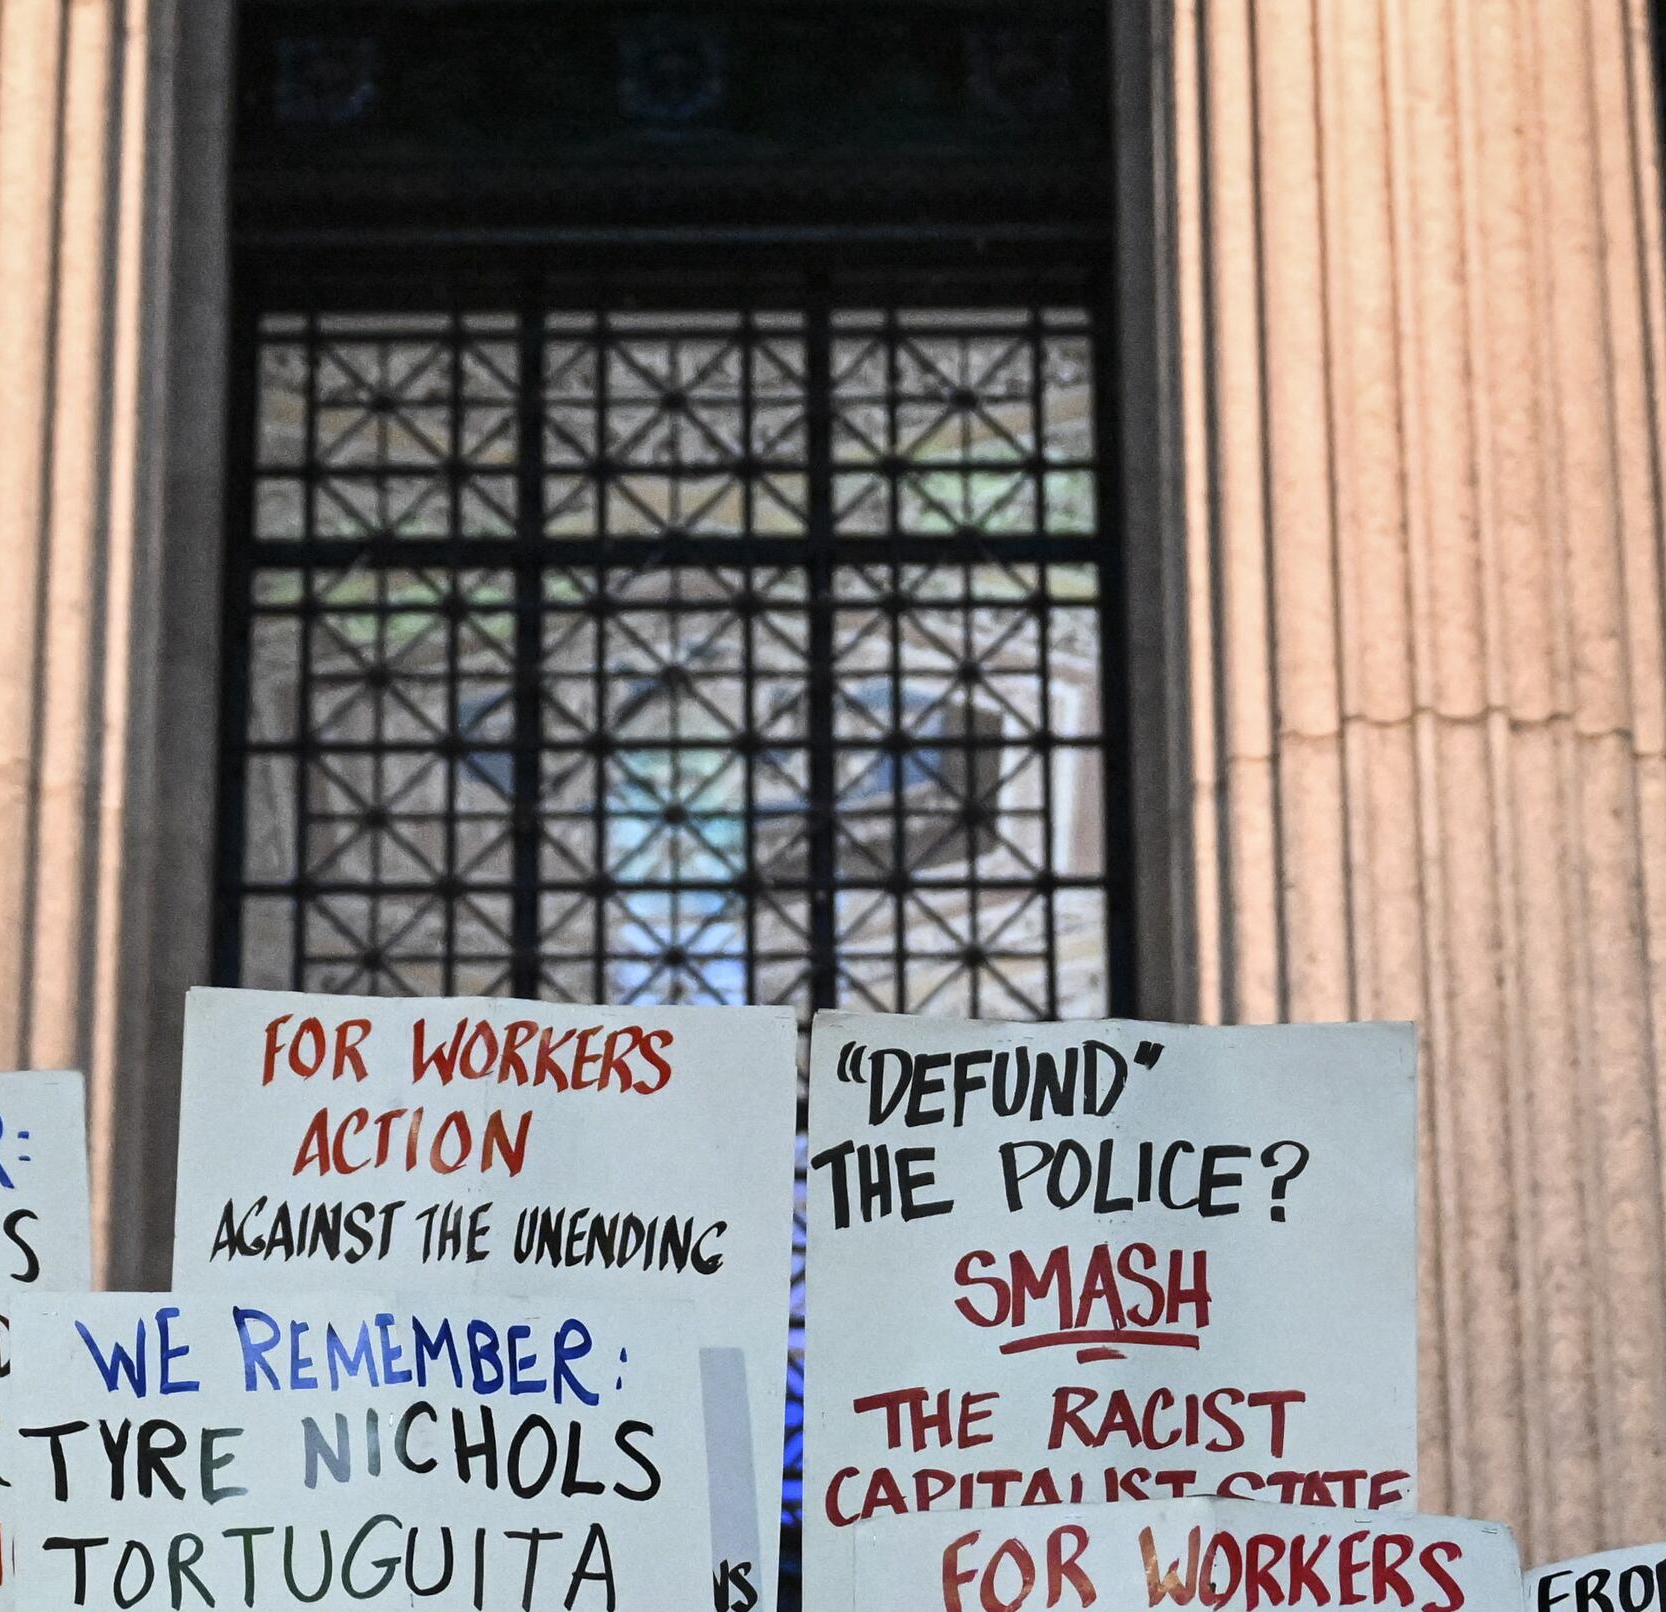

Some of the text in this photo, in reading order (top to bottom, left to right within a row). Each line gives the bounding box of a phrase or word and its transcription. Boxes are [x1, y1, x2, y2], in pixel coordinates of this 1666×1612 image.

[260, 1014, 674, 1095] FOR WORKERS
[292, 1106, 533, 1177] ACTION
[811, 1139, 1309, 1230] THE POLICE?
[209, 1196, 728, 1275] AGAINST THE UNENDING
[954, 1243, 1212, 1331] SMASH
[74, 1305, 629, 1406] WE REMEMBER:
[19, 1401, 662, 1505] TYRE NICHOLS
[853, 1386, 1306, 1458] THE RACIST
